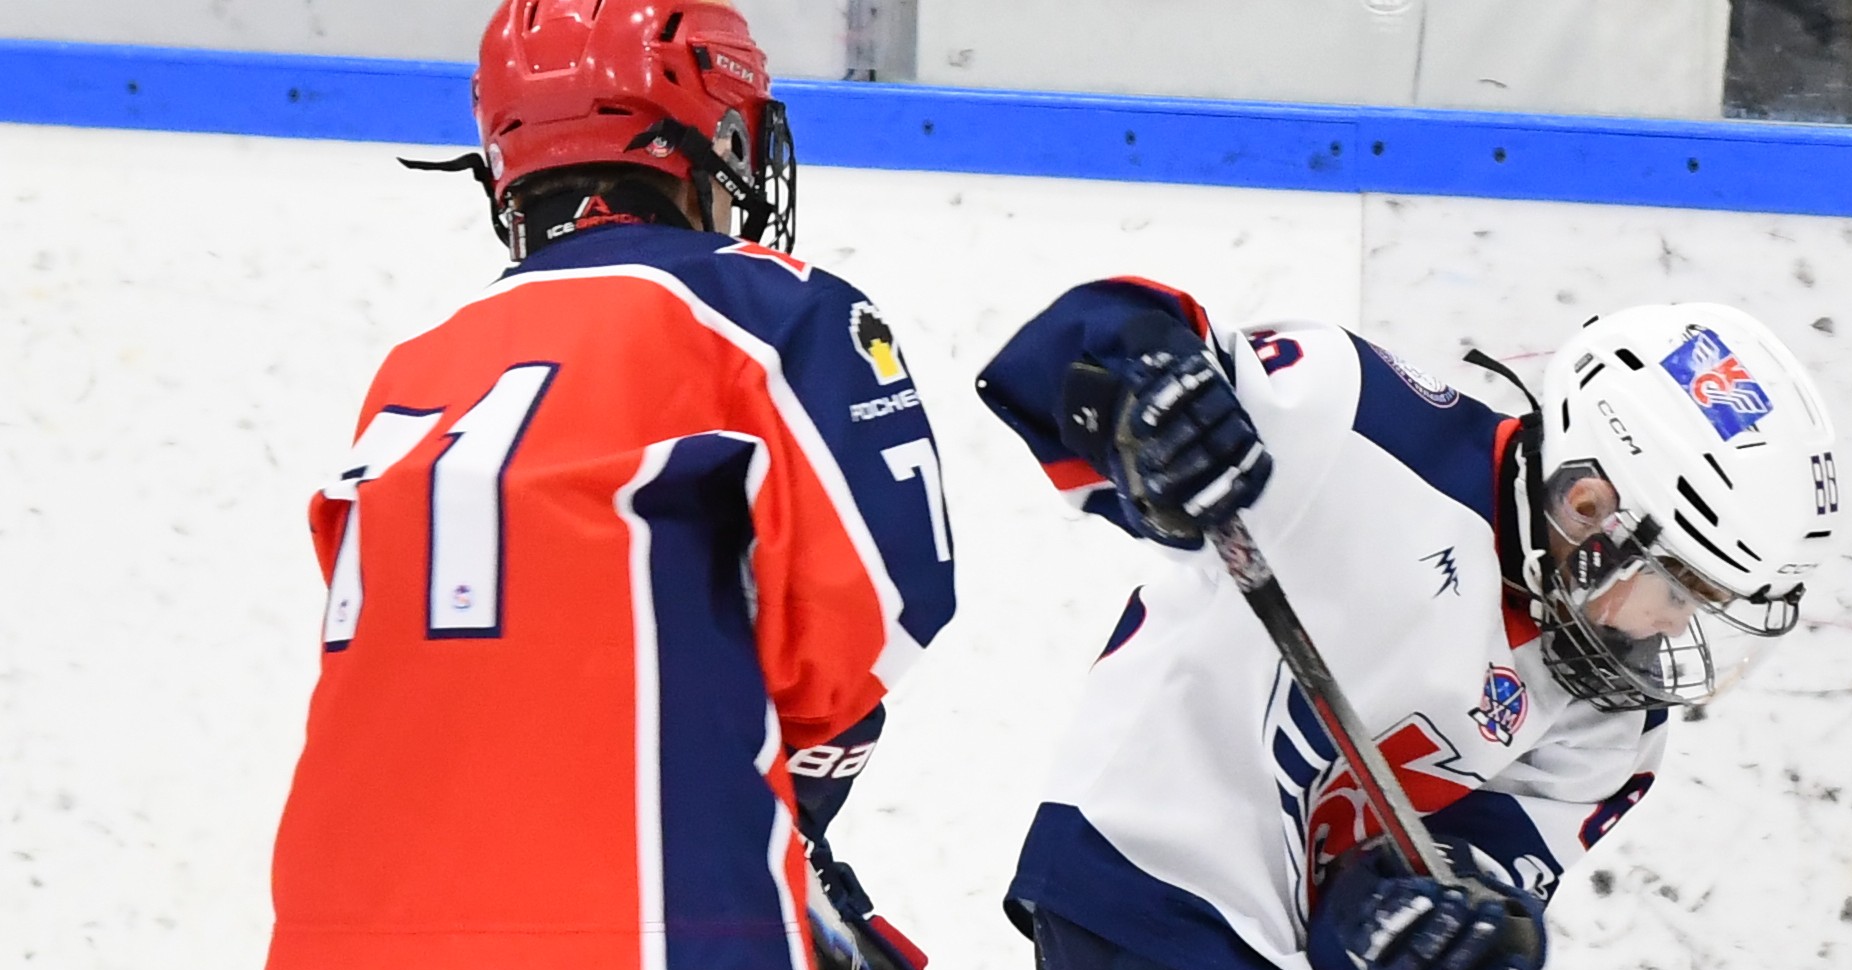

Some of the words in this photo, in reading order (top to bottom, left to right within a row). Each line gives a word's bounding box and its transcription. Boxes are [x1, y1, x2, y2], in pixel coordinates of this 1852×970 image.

[716, 54, 754, 83] CCM
[715, 170, 747, 201] CCM
[1597, 400, 1643, 455] CCM
